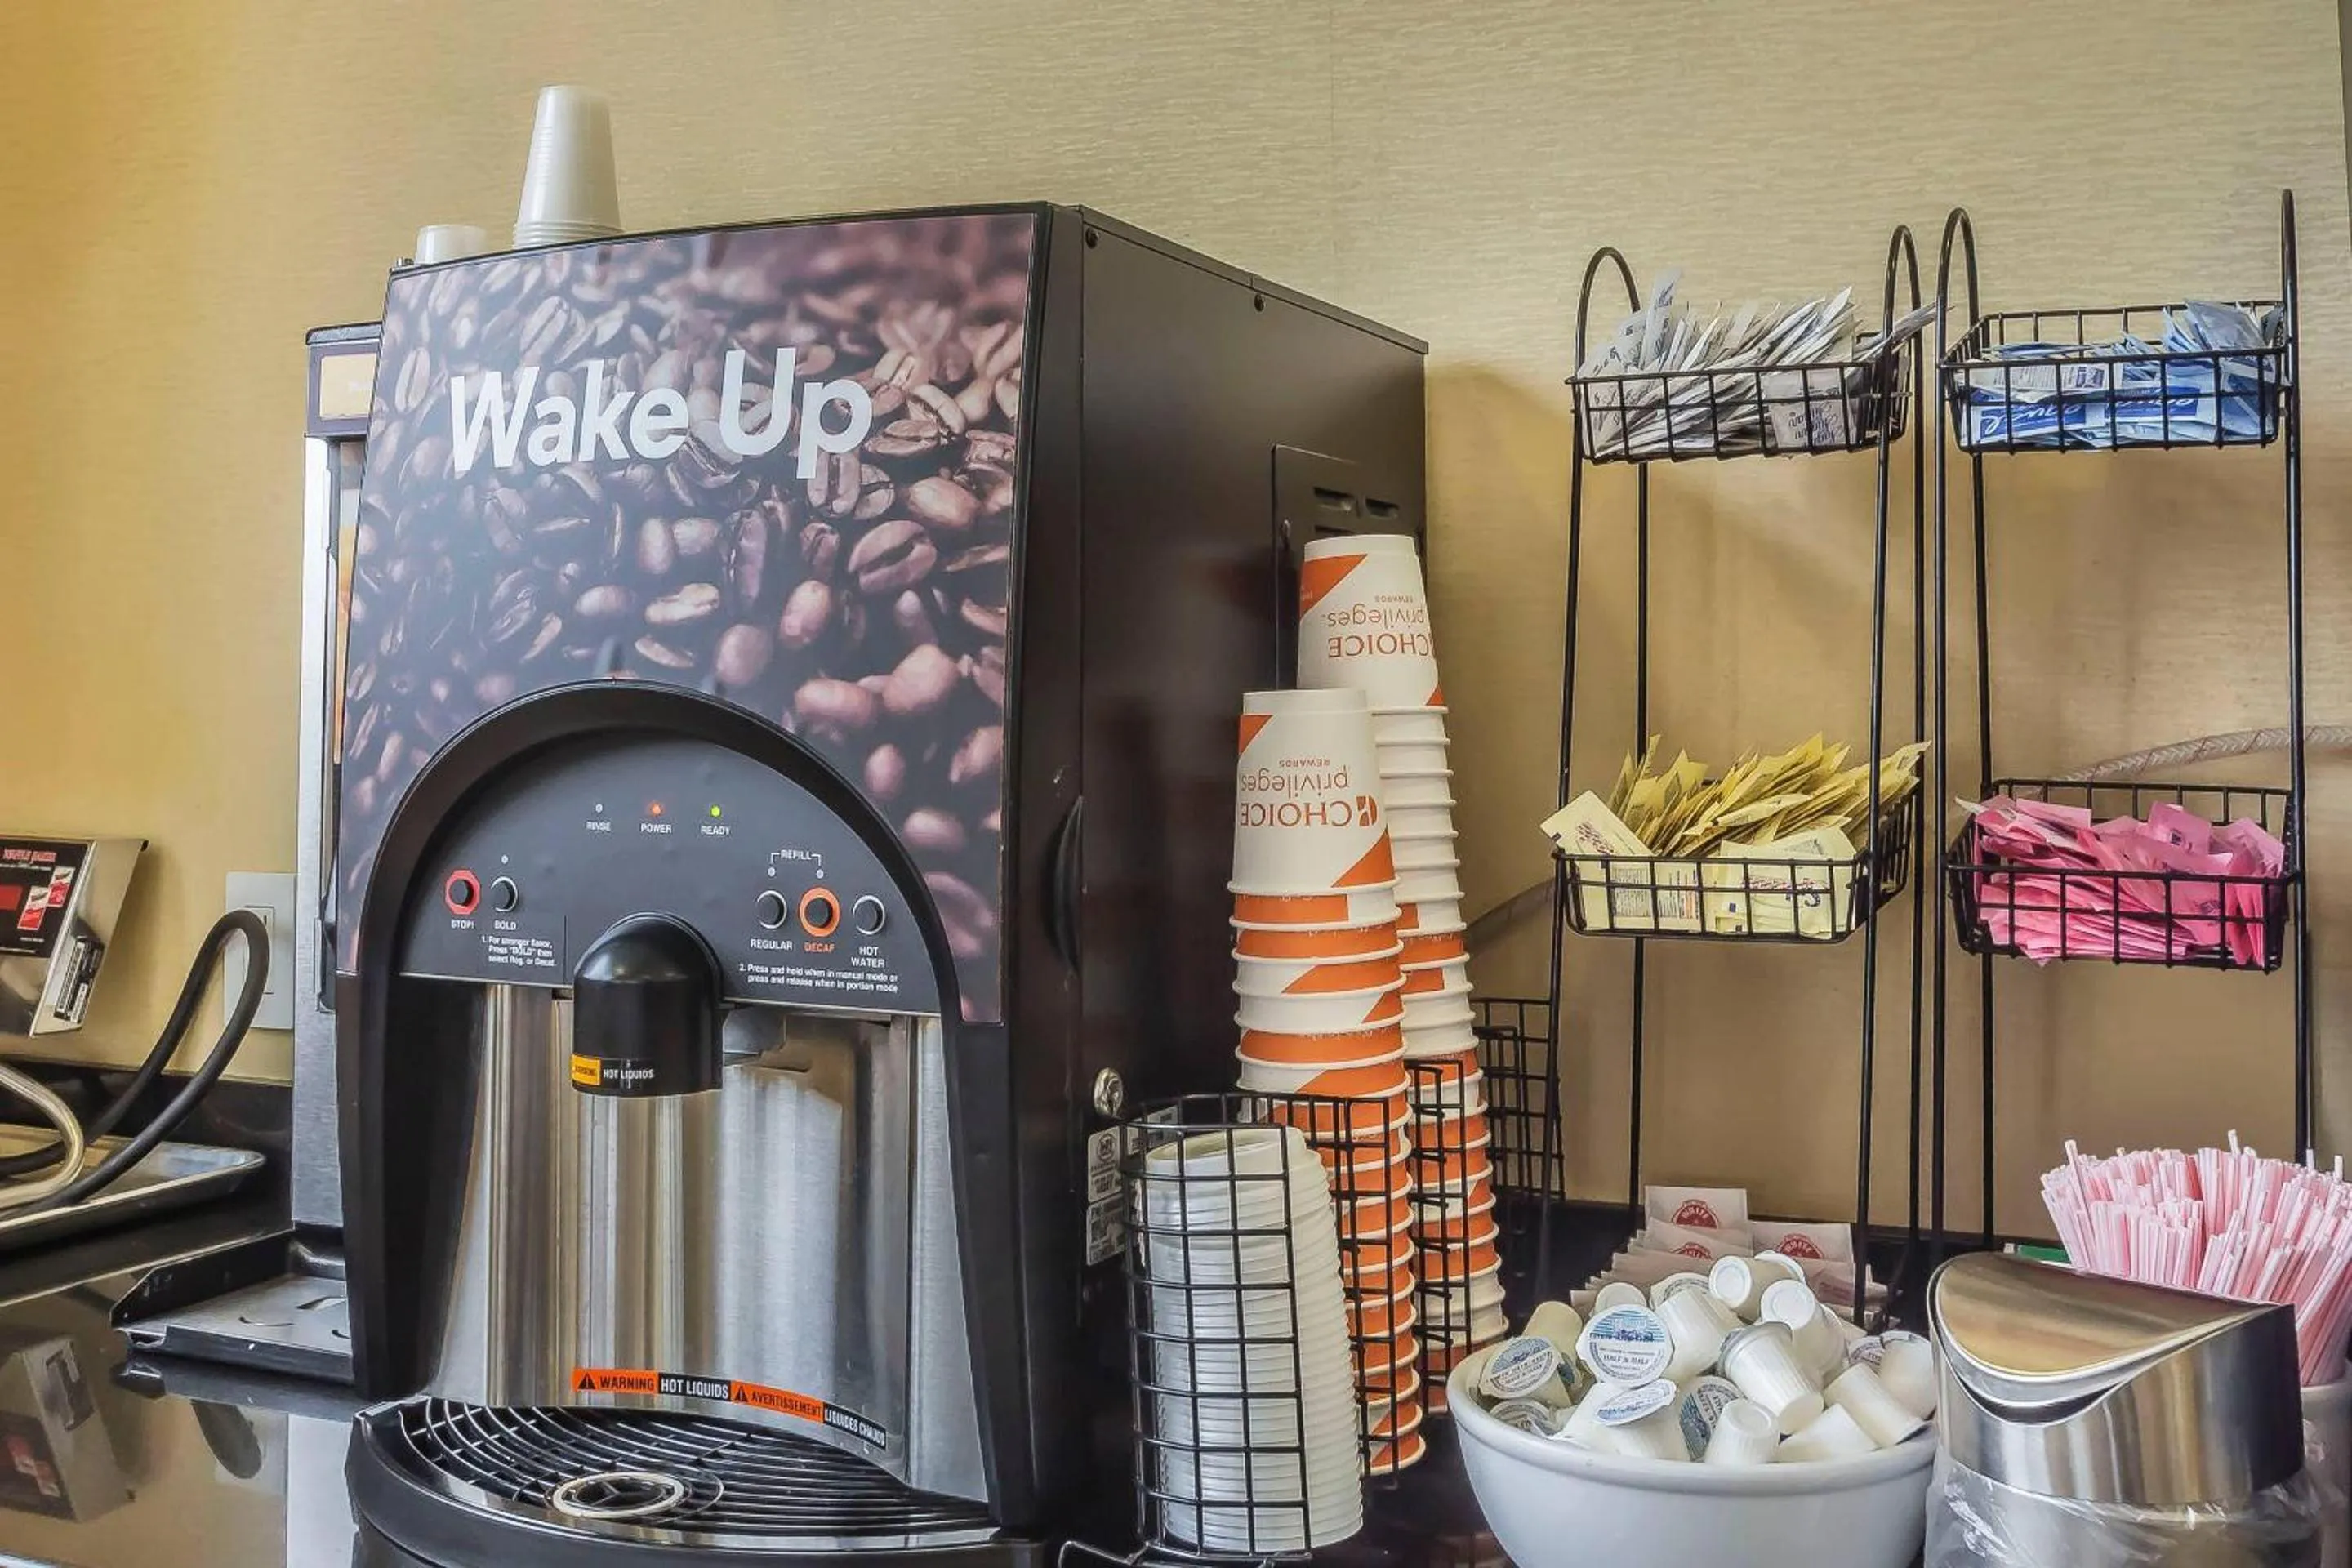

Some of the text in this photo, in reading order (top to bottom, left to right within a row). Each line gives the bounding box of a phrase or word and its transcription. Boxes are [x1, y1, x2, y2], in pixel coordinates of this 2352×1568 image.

[451, 347, 873, 479] Wake Up
[1328, 633, 1430, 658] CHOICE
[1279, 758, 1330, 768] REWARDS
[1241, 764, 1349, 799] privileges
[1240, 800, 1353, 827] CHOICE
[640, 822, 672, 834] POWER
[700, 825, 731, 835] READY
[780, 849, 812, 860] REFILL
[494, 920, 517, 930] BOLD
[751, 938, 793, 951] REGULAR
[804, 942, 835, 953] DECAF
[859, 946, 880, 956] HOT
[851, 956, 885, 969] WATER
[747, 964, 769, 974] Press
[770, 966, 785, 975] and
[786, 966, 804, 976] hold
[804, 969, 826, 978] when
[827, 969, 835, 978] in
[835, 971, 864, 980] manual
[866, 973, 889, 982] mode
[747, 976, 769, 986] press
[770, 976, 785, 985] and
[815, 979, 836, 989] when
[837, 980, 845, 990] in
[846, 982, 875, 993] portion
[876, 983, 898, 994] mode
[603, 1068, 619, 1079] HOT
[621, 1068, 654, 1080] LIQUIDS
[600, 1375, 654, 1389] WARNING
[661, 1378, 729, 1399] HOT LIQUIDS
[751, 1390, 822, 1417] AVERTISSEMENT
[823, 1407, 858, 1432] LIQUIDES
